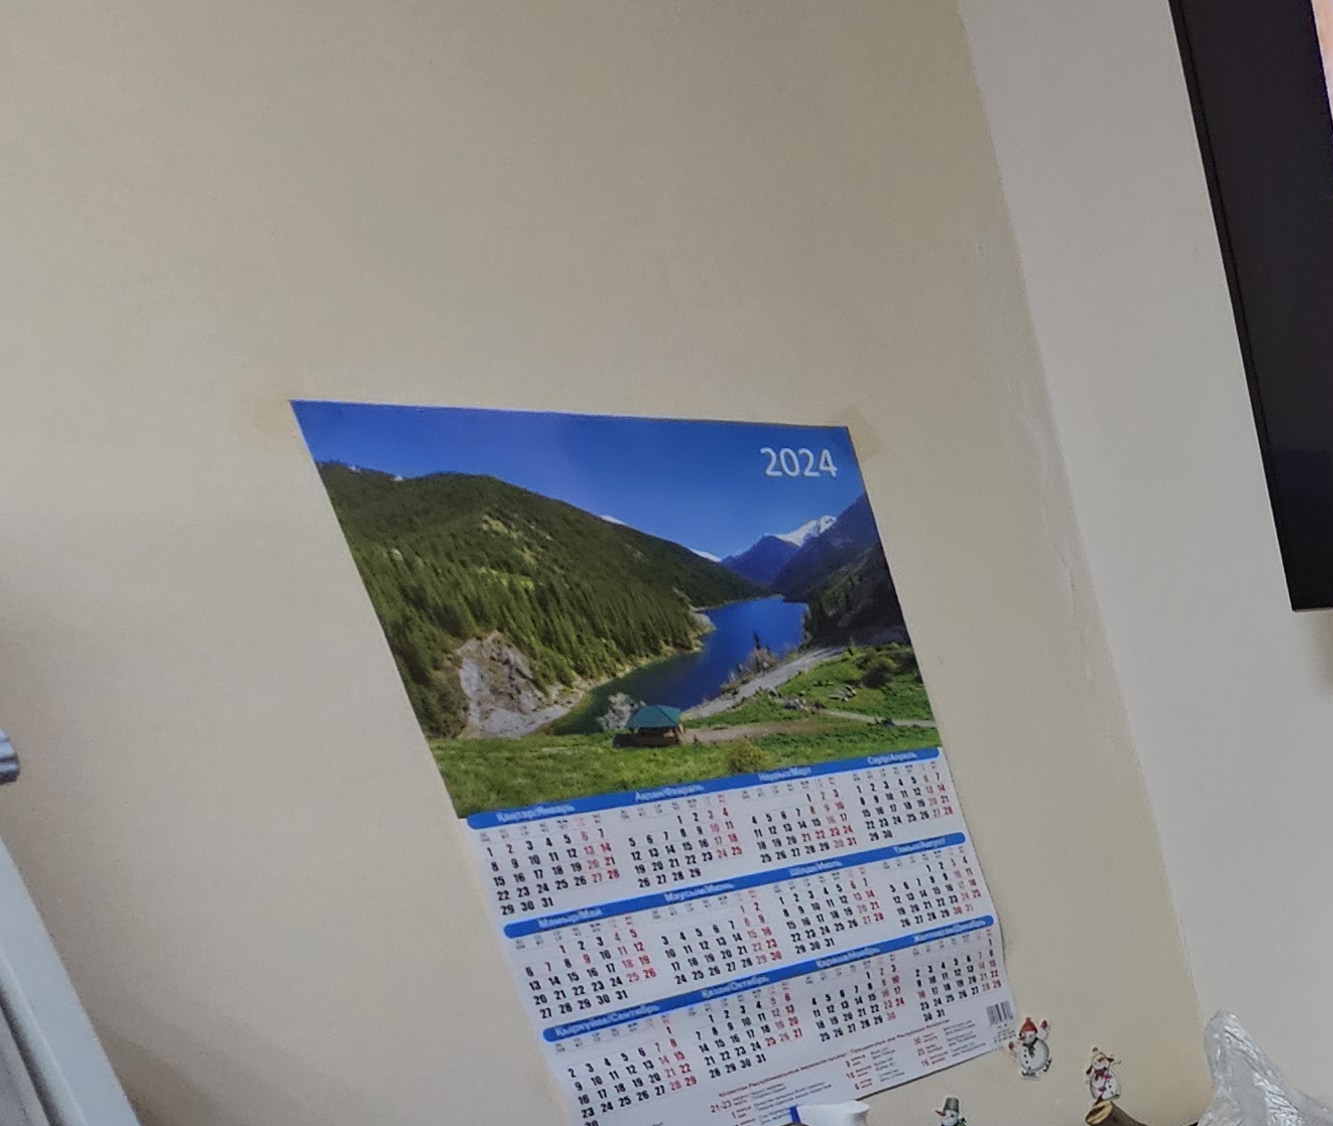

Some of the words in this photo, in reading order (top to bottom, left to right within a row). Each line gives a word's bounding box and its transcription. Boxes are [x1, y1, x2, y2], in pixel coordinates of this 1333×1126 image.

[760, 447, 838, 478] 2024
[528, 855, 541, 865] 10
[549, 852, 559, 861] 11
[567, 848, 577, 858] 12
[600, 843, 611, 852] 14
[493, 876, 505, 886] 15
[513, 873, 525, 883] 16
[533, 869, 543, 879] 17
[552, 865, 564, 875] 18
[570, 862, 582, 872] 19
[605, 856, 615, 866] 21
[497, 890, 510, 901] 22
[517, 886, 530, 897] 23
[536, 883, 549, 894] 24
[555, 879, 568, 890] 25
[574, 876, 587, 886] 26
[607, 869, 619, 879] 28
[500, 904, 514, 915] 29
[521, 901, 534, 911] 30
[541, 897, 553, 907] 31
[599, 950, 611, 960] 10
[634, 942, 644, 951] 12
[529, 981, 541, 991] 13
[548, 976, 561, 985] 14
[567, 972, 579, 982] 15
[586, 968, 598, 977] 16
[606, 963, 615, 973] 17
[639, 955, 650, 965] 19
[533, 994, 547, 1005] 20
[554, 990, 566, 1000] 21
[572, 985, 585, 996] 22
[591, 981, 604, 992] 23
[610, 976, 623, 987] 24
[643, 968, 656, 978] 26
[540, 1008, 552, 1019] 27
[559, 1002, 572, 1014] 28
[578, 998, 591, 1009] 29
[596, 994, 610, 1005] 30
[616, 990, 628, 1000] 31
[578, 1094, 590, 1105] 16
[597, 1089, 607, 1099] 17
[614, 1083, 626, 1093] 18
[632, 1078, 643, 1087] 19
[648, 1073, 661, 1083] 20
[679, 1063, 691, 1074] 22
[591, 1076, 603, 1086] 10
[609, 1071, 619, 1080] 11
[626, 1065, 637, 1075] 12
[643, 1060, 654, 1070] 13
[674, 1051, 685, 1060] 15
[582, 1107, 594, 1118] 23
[601, 1102, 613, 1112] 24
[619, 1096, 631, 1107] 25
[636, 1090, 649, 1101] 26
[655, 1085, 665, 1096] 27
[684, 1076, 696, 1086] 29
